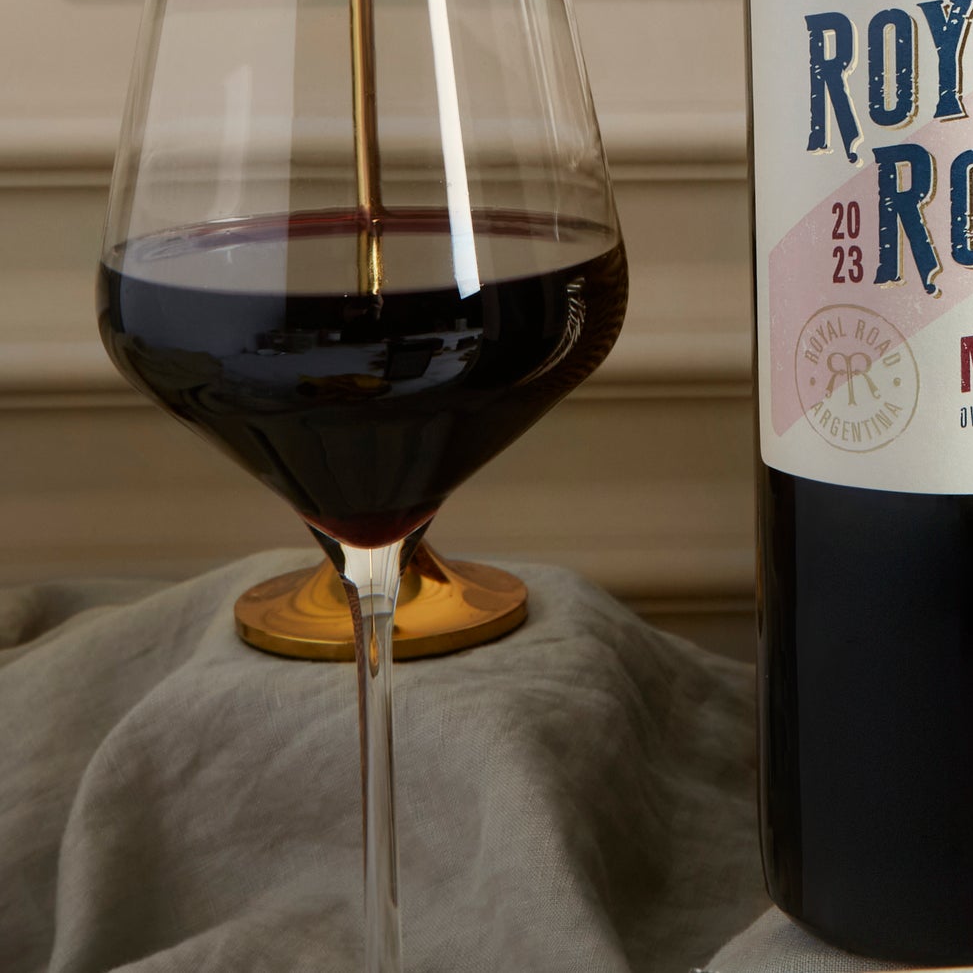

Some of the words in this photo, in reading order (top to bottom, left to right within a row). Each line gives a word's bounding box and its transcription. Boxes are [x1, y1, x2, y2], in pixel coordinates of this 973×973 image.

[831, 201, 861, 240] 20
[832, 246, 864, 283] 23
[804, 317, 847, 365] ROYAL
[855, 319, 901, 367] ROAD
[810, 401, 903, 443] ARGENTINA
